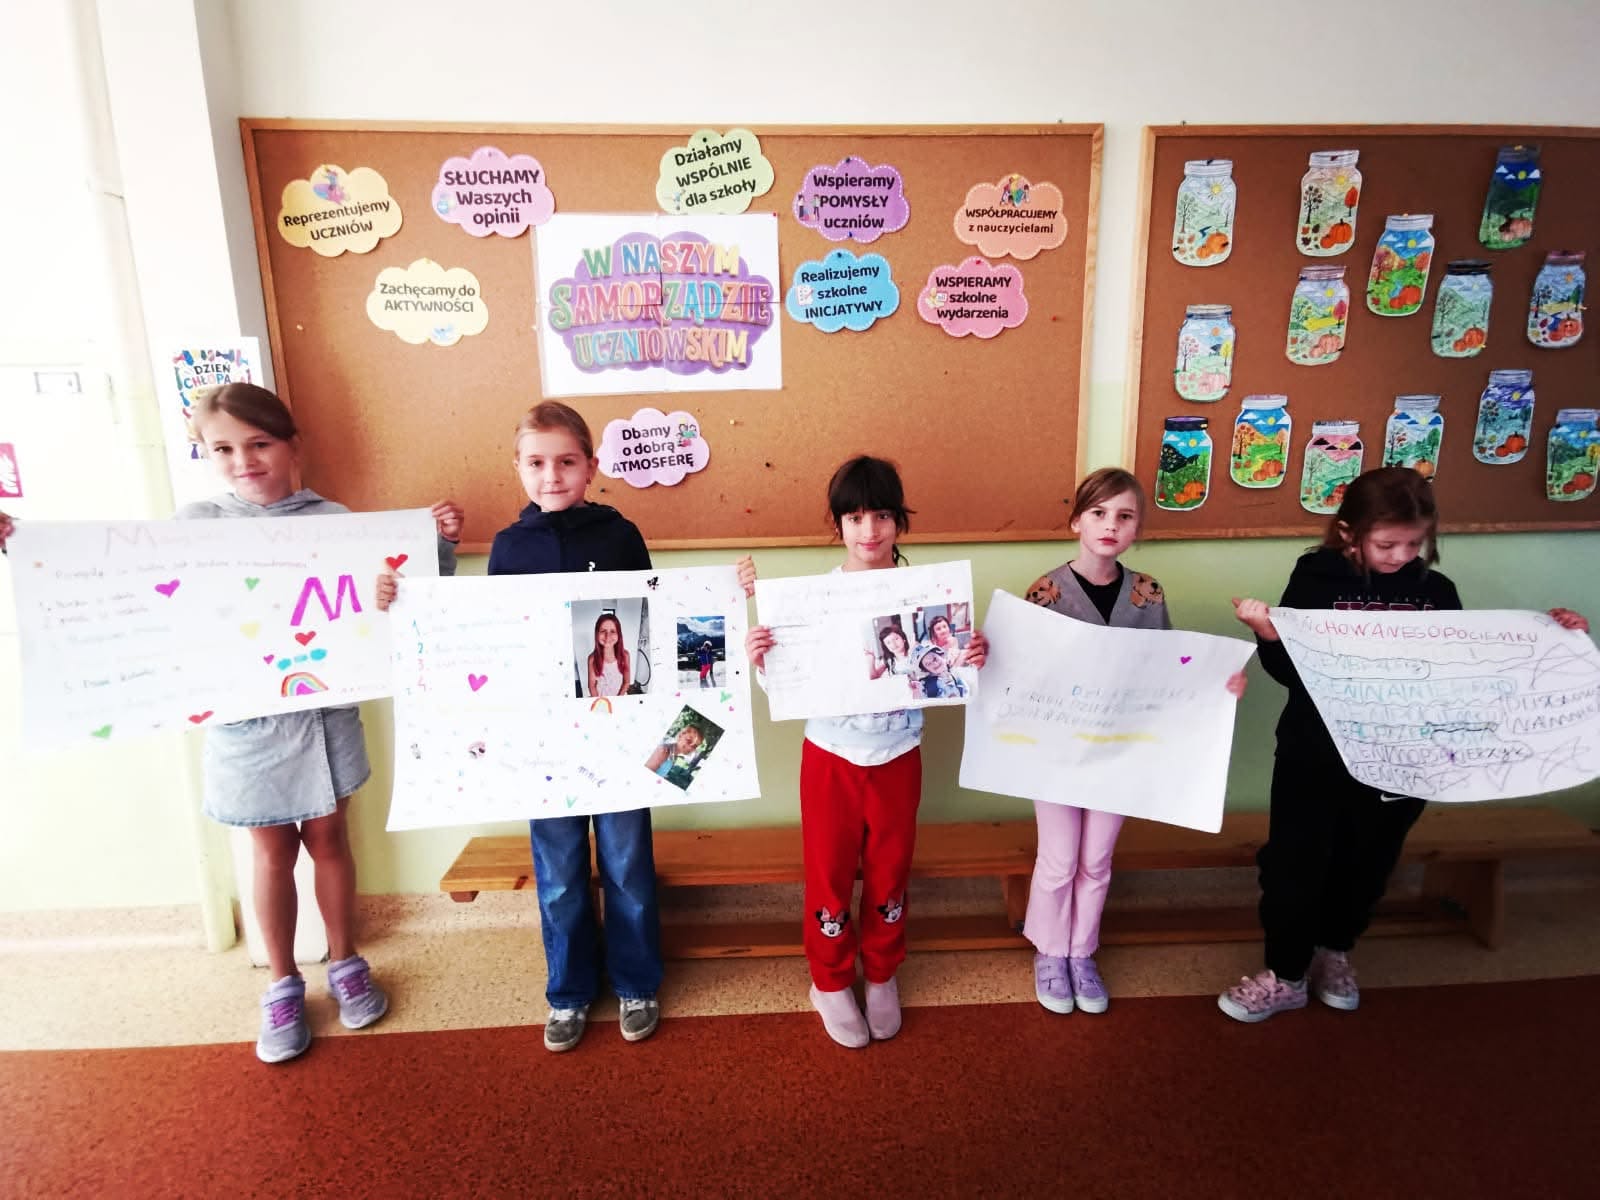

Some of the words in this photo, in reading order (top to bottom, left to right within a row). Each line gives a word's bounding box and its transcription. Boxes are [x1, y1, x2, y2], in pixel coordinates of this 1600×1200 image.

[674, 138, 743, 167] Działamy
[444, 169, 540, 187] SŁUCHAMY
[676, 157, 752, 188] WSPÓLNIE
[813, 174, 895, 189] Wspieramy
[456, 189, 532, 207] Waszych
[685, 191, 707, 208] dla
[710, 178, 757, 201] szkoły
[820, 195, 889, 208] POMYSŁY
[283, 200, 390, 227] Reprezentujemy
[473, 208, 520, 227] opinii
[965, 206, 1057, 219] WSPÓŁPRACUJEMY
[310, 219, 373, 241] UCZNIÓW
[824, 214, 884, 229] uczniów
[969, 223, 975, 232] z
[976, 222, 1054, 235] nauczycielami
[582, 245, 611, 278] W
[621, 240, 740, 277] NASZYM
[801, 264, 880, 283] Realizujemy
[935, 276, 1012, 288] WSPIERAMY
[380, 283, 456, 297] Zachęcamy
[459, 284, 476, 296] do
[817, 284, 867, 299] szkolne
[949, 291, 997, 303] szkolne
[384, 297, 474, 313] AKTYWNOŚCI
[550, 281, 772, 330] SAMORZĄDZIE
[805, 300, 883, 319] INICJATYWY
[937, 306, 1009, 320] wydarzenia
[573, 327, 749, 368] UCZNIOWSKIM
[194, 362, 231, 375] DZIEŃ
[621, 426, 671, 440] Dbamy
[622, 447, 631, 456] o
[634, 441, 675, 454] dobrą
[612, 453, 694, 473] ATMOSFERĘ
